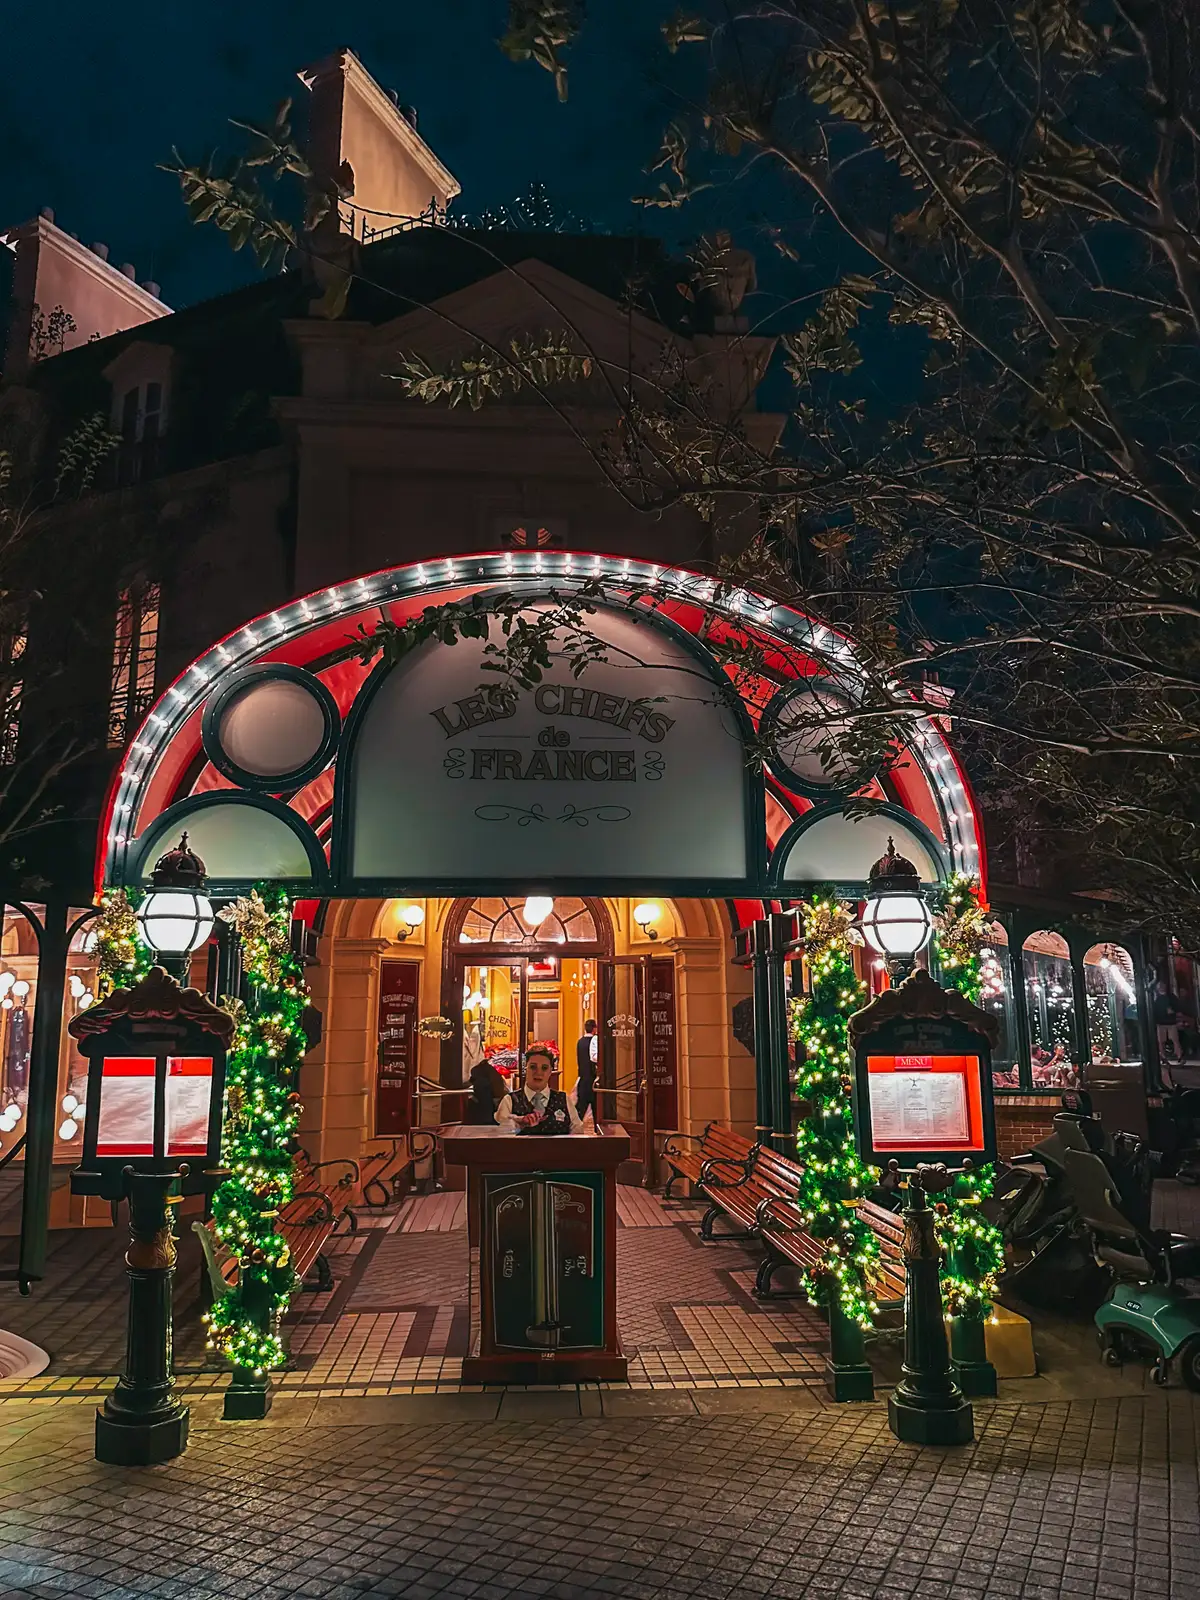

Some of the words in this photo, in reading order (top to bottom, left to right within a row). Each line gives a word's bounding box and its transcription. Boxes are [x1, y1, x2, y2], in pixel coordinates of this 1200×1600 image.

[430, 684, 517, 739] LES
[534, 684, 676, 743] CHEFS
[538, 726, 570, 747] de
[470, 748, 637, 782] FRANCE
[654, 1024, 673, 1036] CARTE
[901, 1058, 928, 1066] MENU
